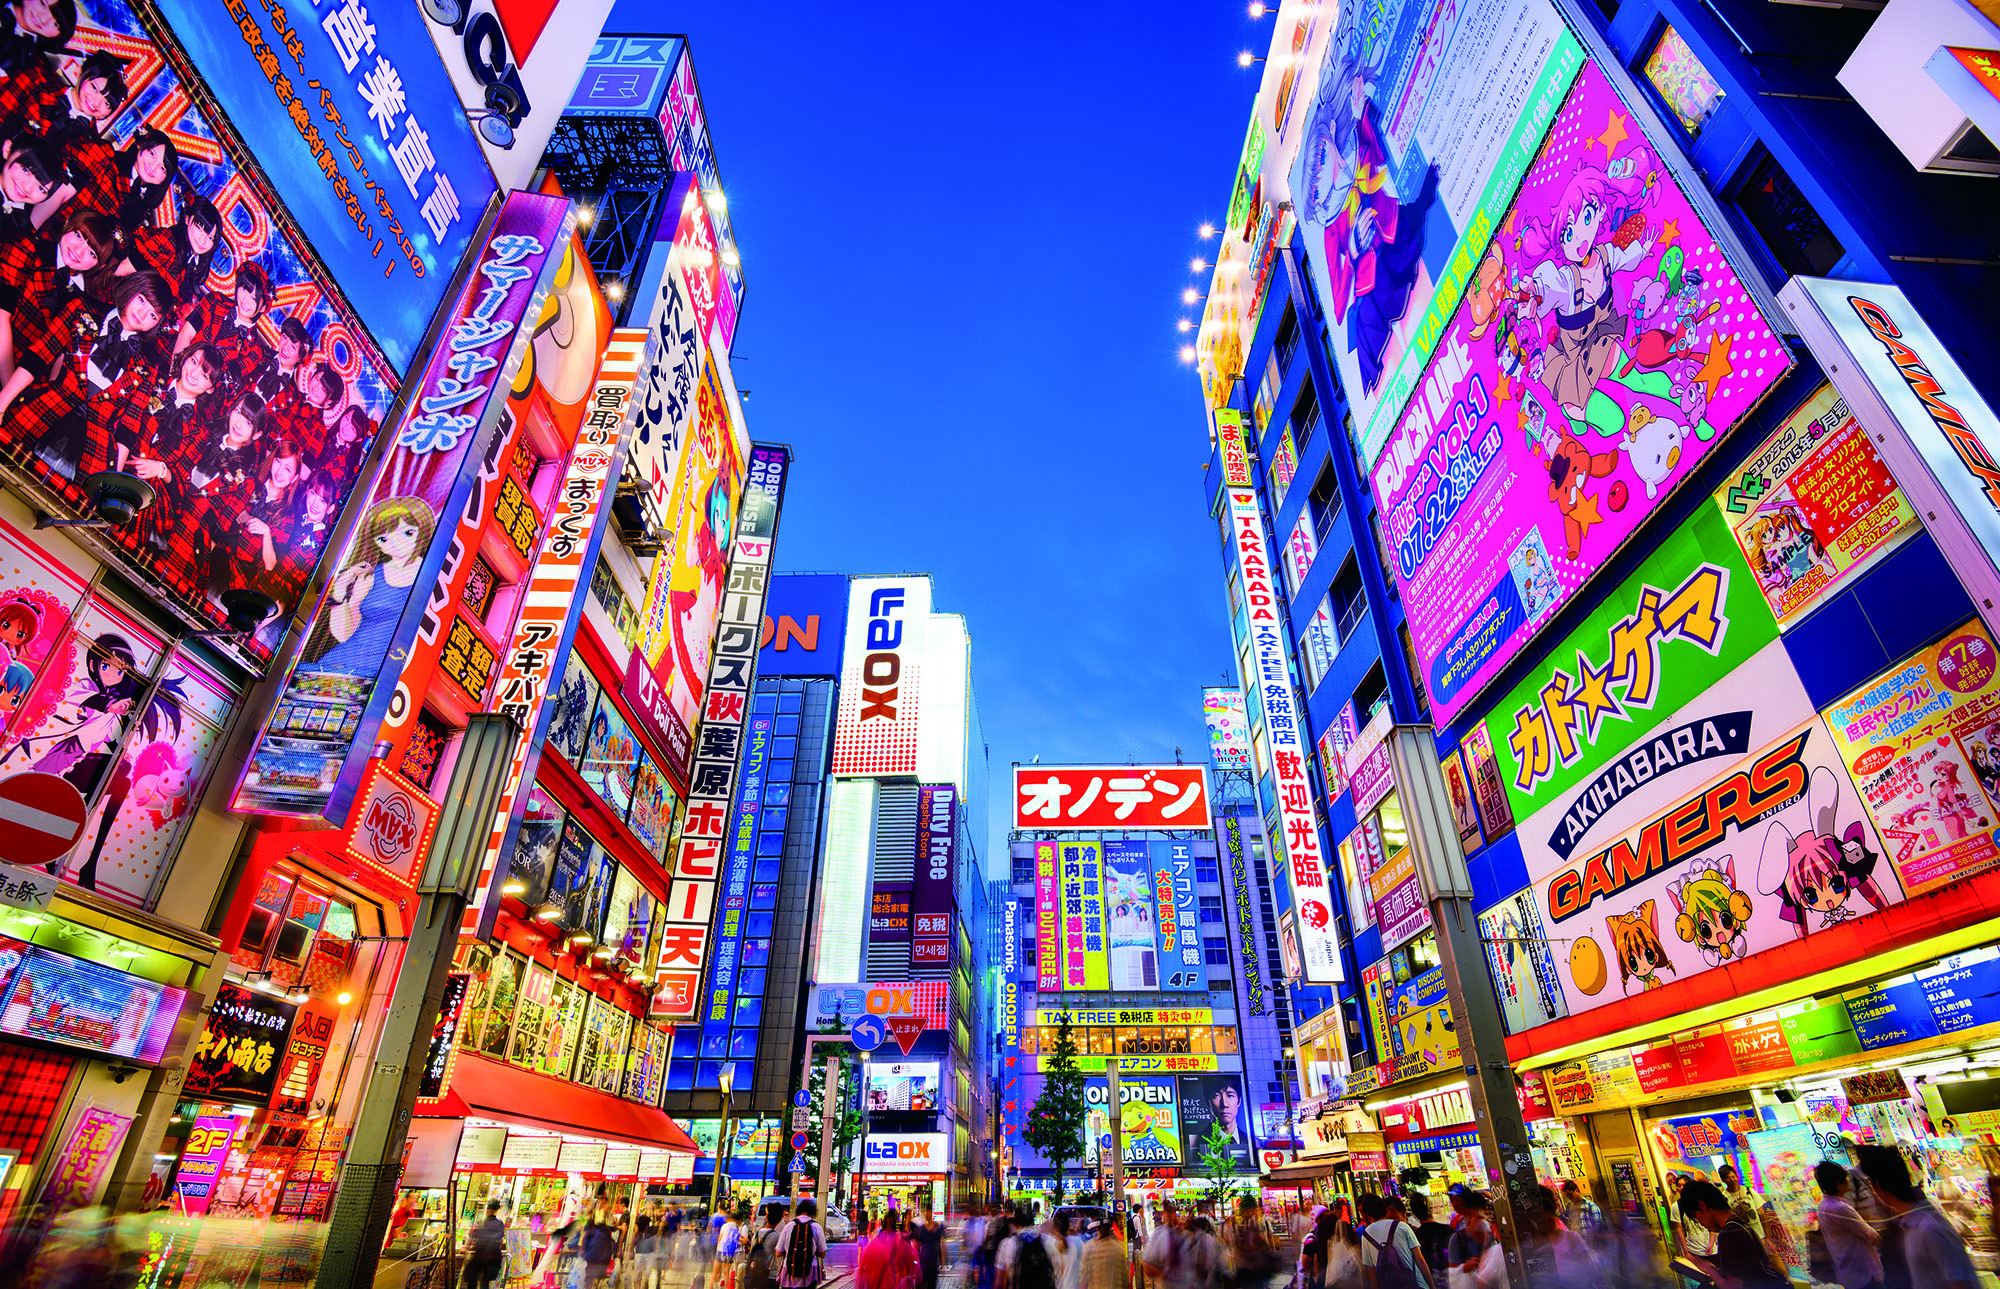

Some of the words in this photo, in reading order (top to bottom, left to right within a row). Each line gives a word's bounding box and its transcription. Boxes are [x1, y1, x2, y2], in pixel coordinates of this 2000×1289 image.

[399, 235, 544, 454] サマージャンボ
[586, 386, 628, 446] 買取り
[765, 451, 784, 505] HOBBY
[1221, 423, 1249, 484] まんが喫茶
[743, 450, 769, 534] PARADISE
[551, 478, 598, 559] まっくす
[1236, 516, 1275, 621] TAKARADA
[1762, 532, 1815, 579] SAMPLE
[1265, 684, 1297, 745] 免税商店
[933, 790, 953, 834] Duty
[1019, 769, 1202, 820] オノデン
[1274, 750, 1324, 888] 歓迎光臨
[1547, 726, 1814, 925] GAMERS
[929, 837, 951, 880] Free
[1081, 846, 1100, 896] 冷蔵庫
[1171, 845, 1194, 908] エアコン
[873, 893, 892, 903] 本店
[917, 917, 947, 932] 免税
[1004, 900, 1017, 974] Panasonic
[1178, 910, 1201, 966] 扇風機
[1168, 972, 1197, 987] 4F
[1417, 968, 1443, 989] DISCOUN
[296, 1012, 333, 1041] 入口
[895, 1025, 920, 1034] 止まれ
[1005, 982, 1017, 1046] ONODEN
[1077, 1011, 1117, 1024] FREE
[1119, 1011, 1154, 1023] 免税店
[289, 1038, 326, 1061] はコチラ
[1119, 1058, 1162, 1069] エアコン
[1005, 1055, 1018, 1136] オノデン
[185, 1129, 229, 1155] 2F
